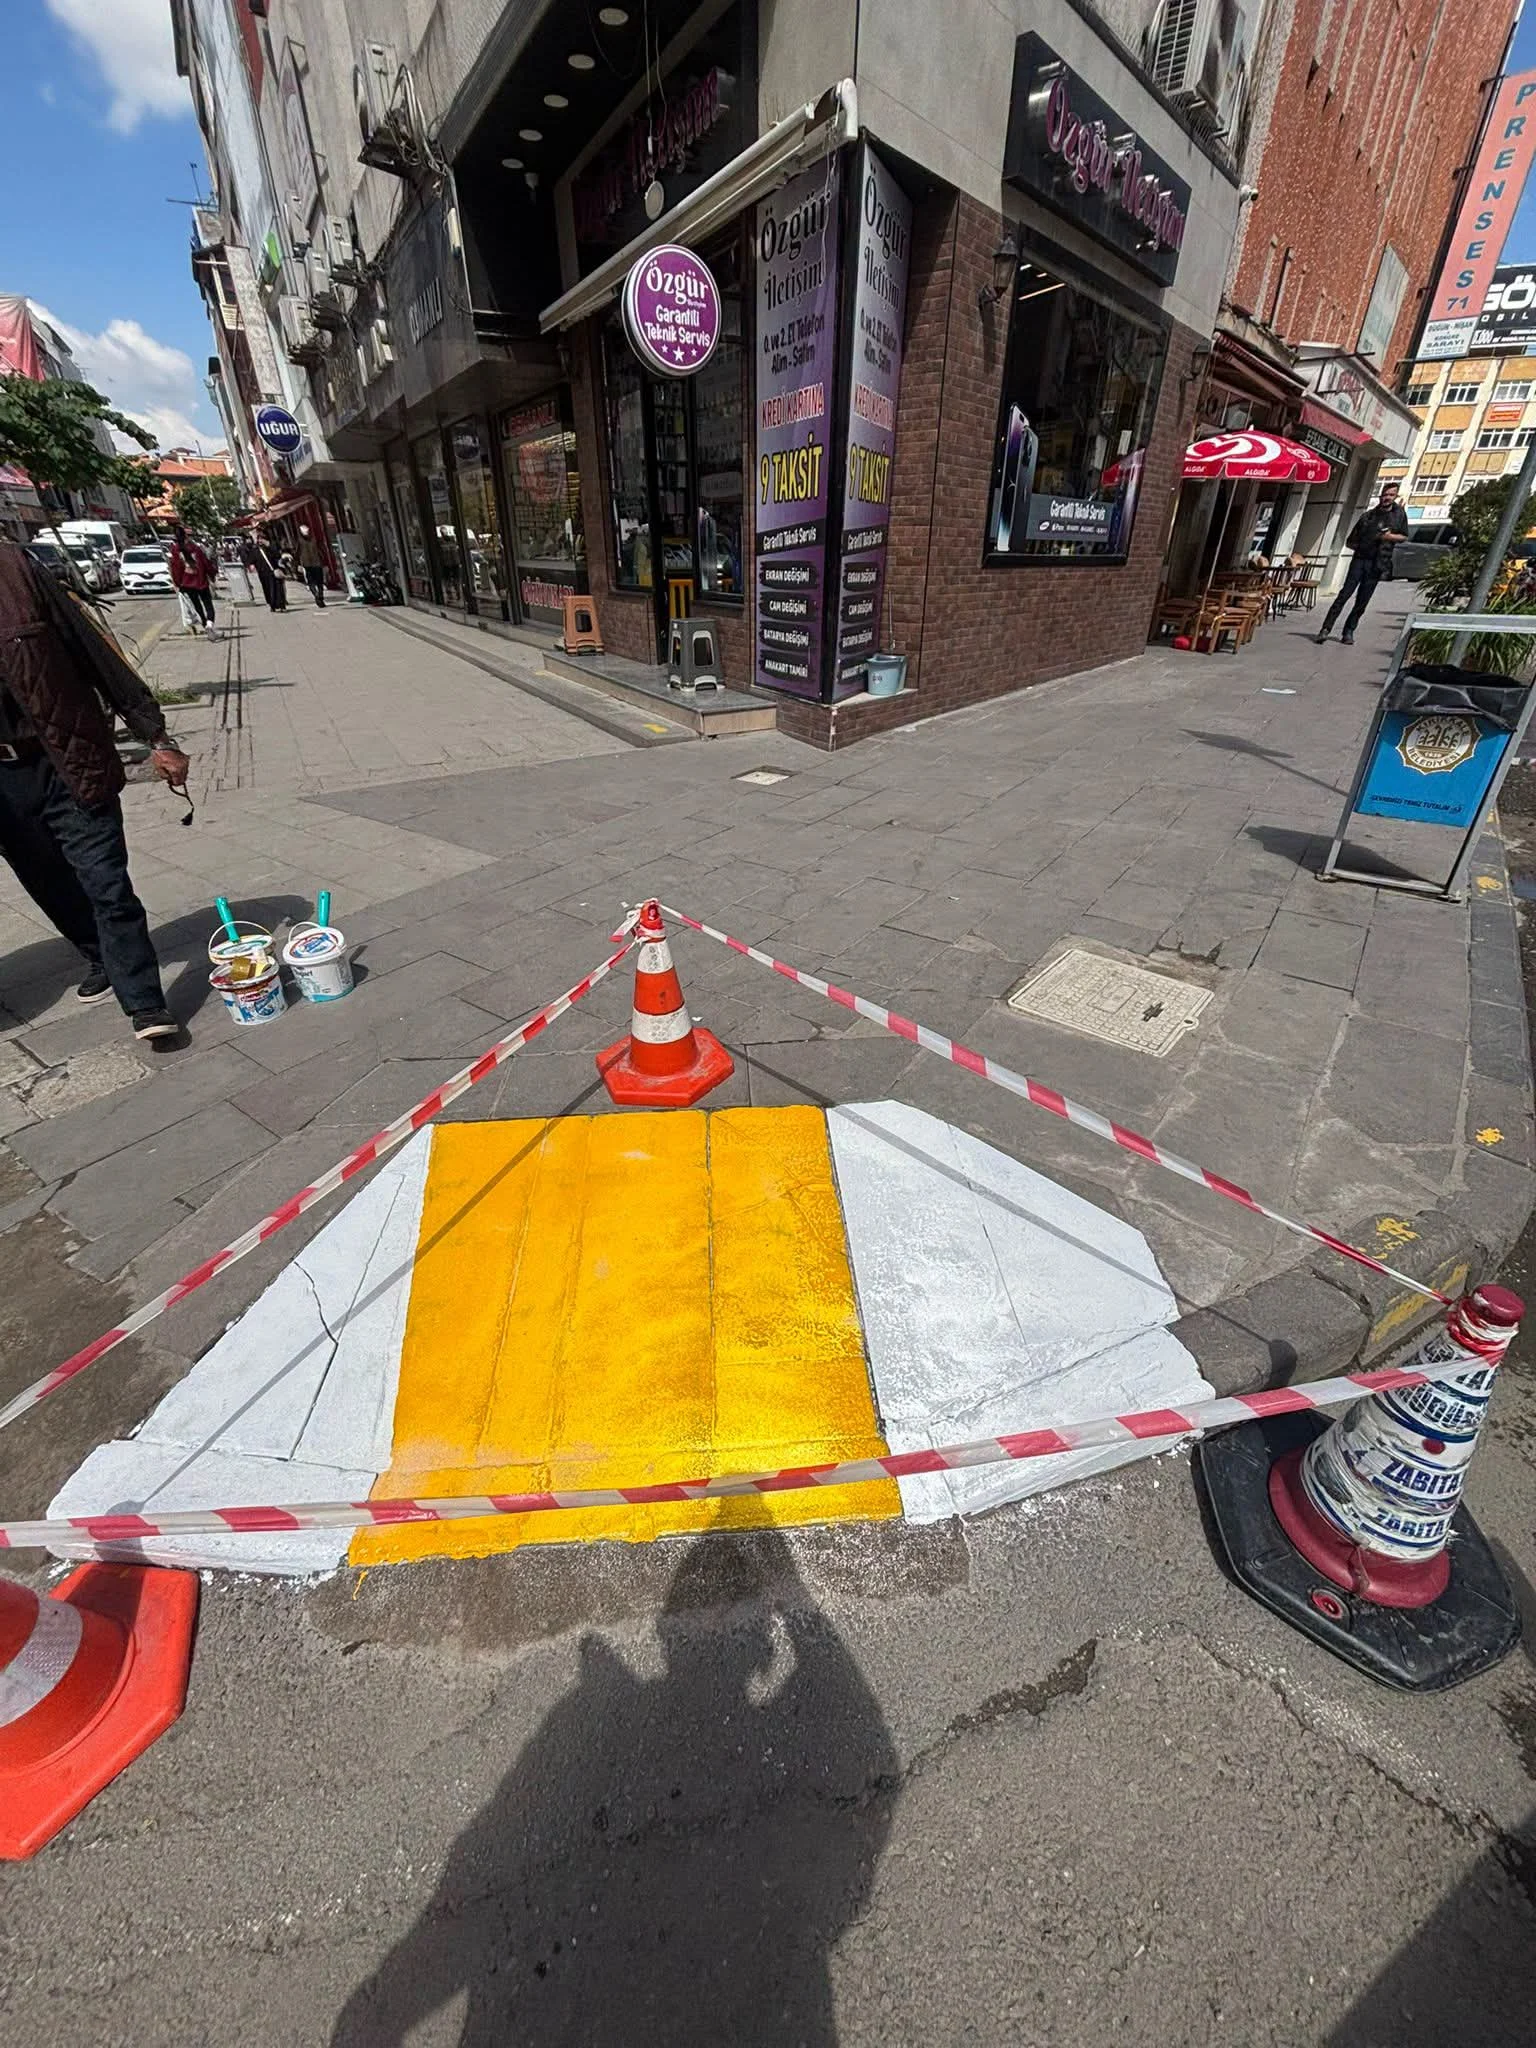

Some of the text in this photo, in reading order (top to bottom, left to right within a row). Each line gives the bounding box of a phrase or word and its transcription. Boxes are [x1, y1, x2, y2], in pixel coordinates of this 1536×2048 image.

[1046, 62, 1115, 194] Özgür
[1455, 83, 1536, 289] PRENSES
[760, 190, 831, 262] Özgür
[864, 163, 908, 260] Özgür
[646, 260, 709, 305] Özgür
[764, 260, 824, 311] İletişim
[864, 238, 900, 312] İletişim
[656, 304, 700, 327] Garantili
[1447, 296, 1469, 311] 71
[645, 322, 711, 348] Teknik Servis
[761, 381, 825, 430] KREDİ KARTINA
[259, 421, 299, 436] UĞUR
[760, 431, 823, 504] 9 TAKSİT
[849, 440, 890, 504] 9 TAKSİT
[799, 525, 817, 544] Servis
[765, 570, 784, 581] EKRAN
[769, 600, 782, 613] CAM
[763, 629, 785, 642] BATARYA
[764, 659, 789, 674] ANAKART
[1381, 1456, 1460, 1495] ZABITA
